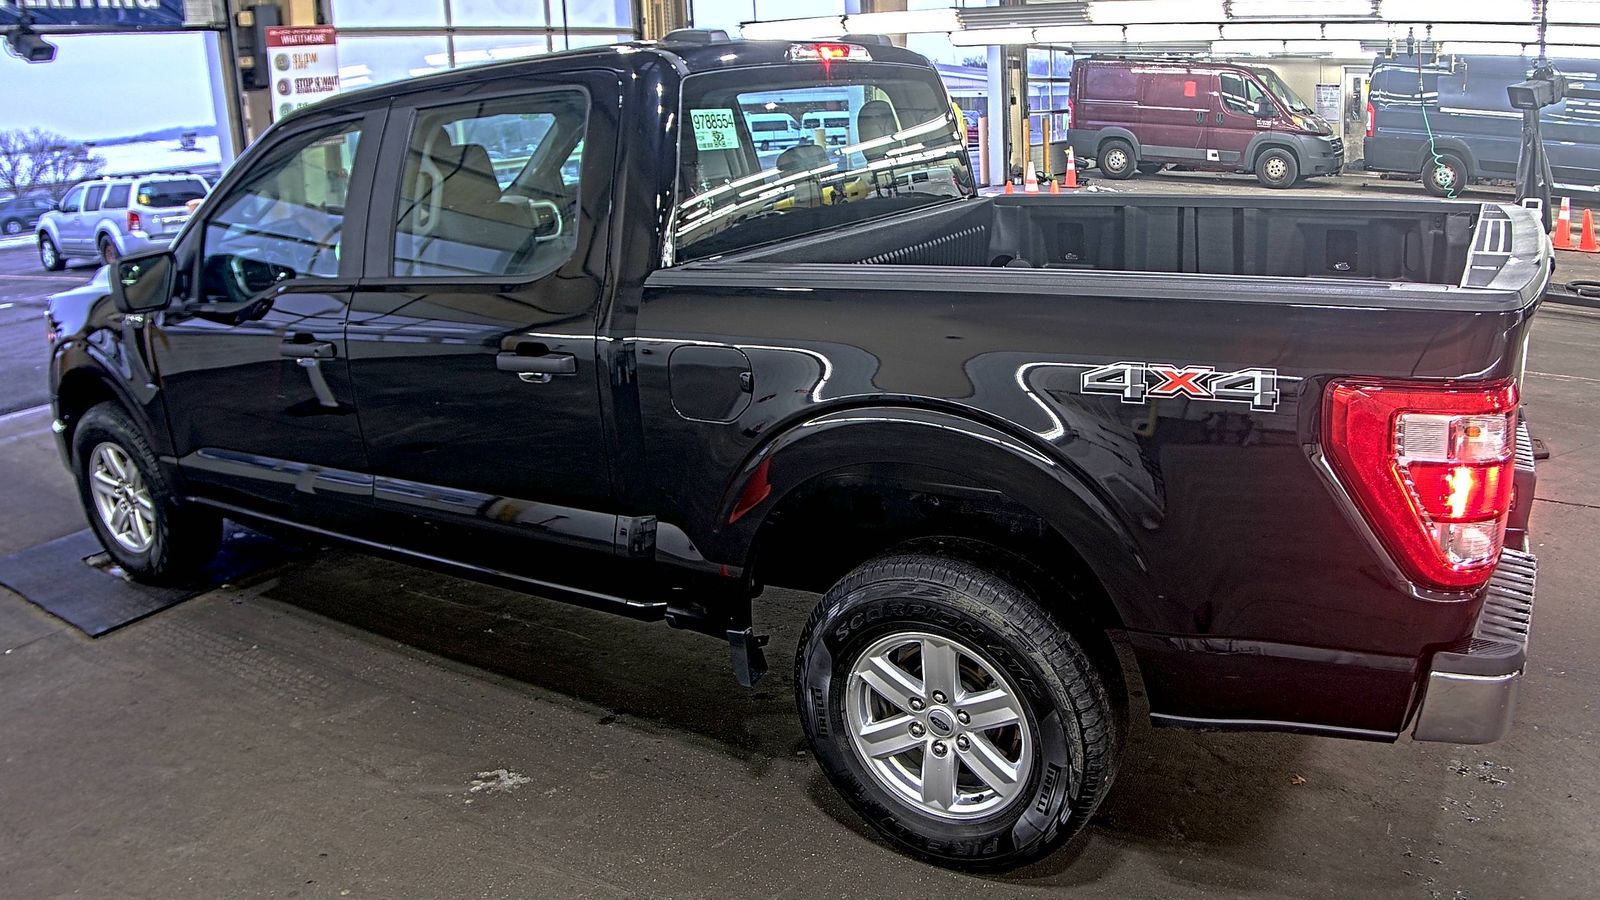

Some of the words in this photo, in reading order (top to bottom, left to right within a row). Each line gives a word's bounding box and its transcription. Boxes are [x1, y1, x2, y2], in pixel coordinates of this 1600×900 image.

[293, 53, 317, 63] SLOW
[295, 77, 313, 88] STOP
[321, 75, 339, 86] WAIT
[693, 113, 734, 130] 9788554
[835, 602, 985, 643] SCORPION
[810, 687, 830, 738] PIRELLI
[1035, 764, 1063, 818] PIRELLI
